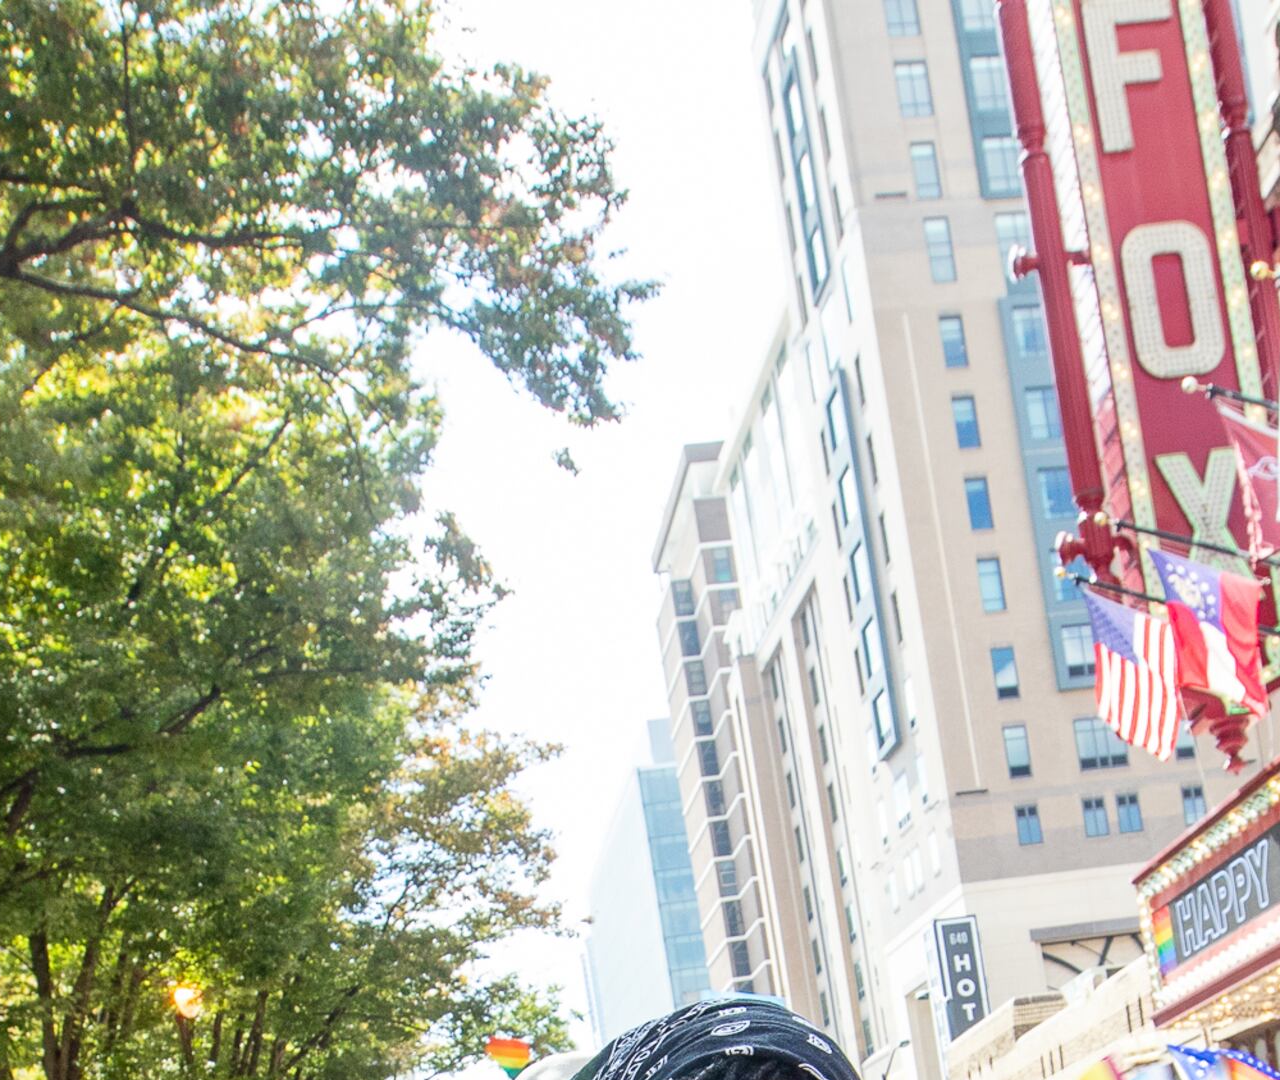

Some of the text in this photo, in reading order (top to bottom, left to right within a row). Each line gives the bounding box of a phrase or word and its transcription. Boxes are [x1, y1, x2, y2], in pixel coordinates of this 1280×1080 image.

[1081, 0, 1257, 583] FOX
[1174, 838, 1270, 957] HAPPY
[953, 953, 976, 1021] HOT
